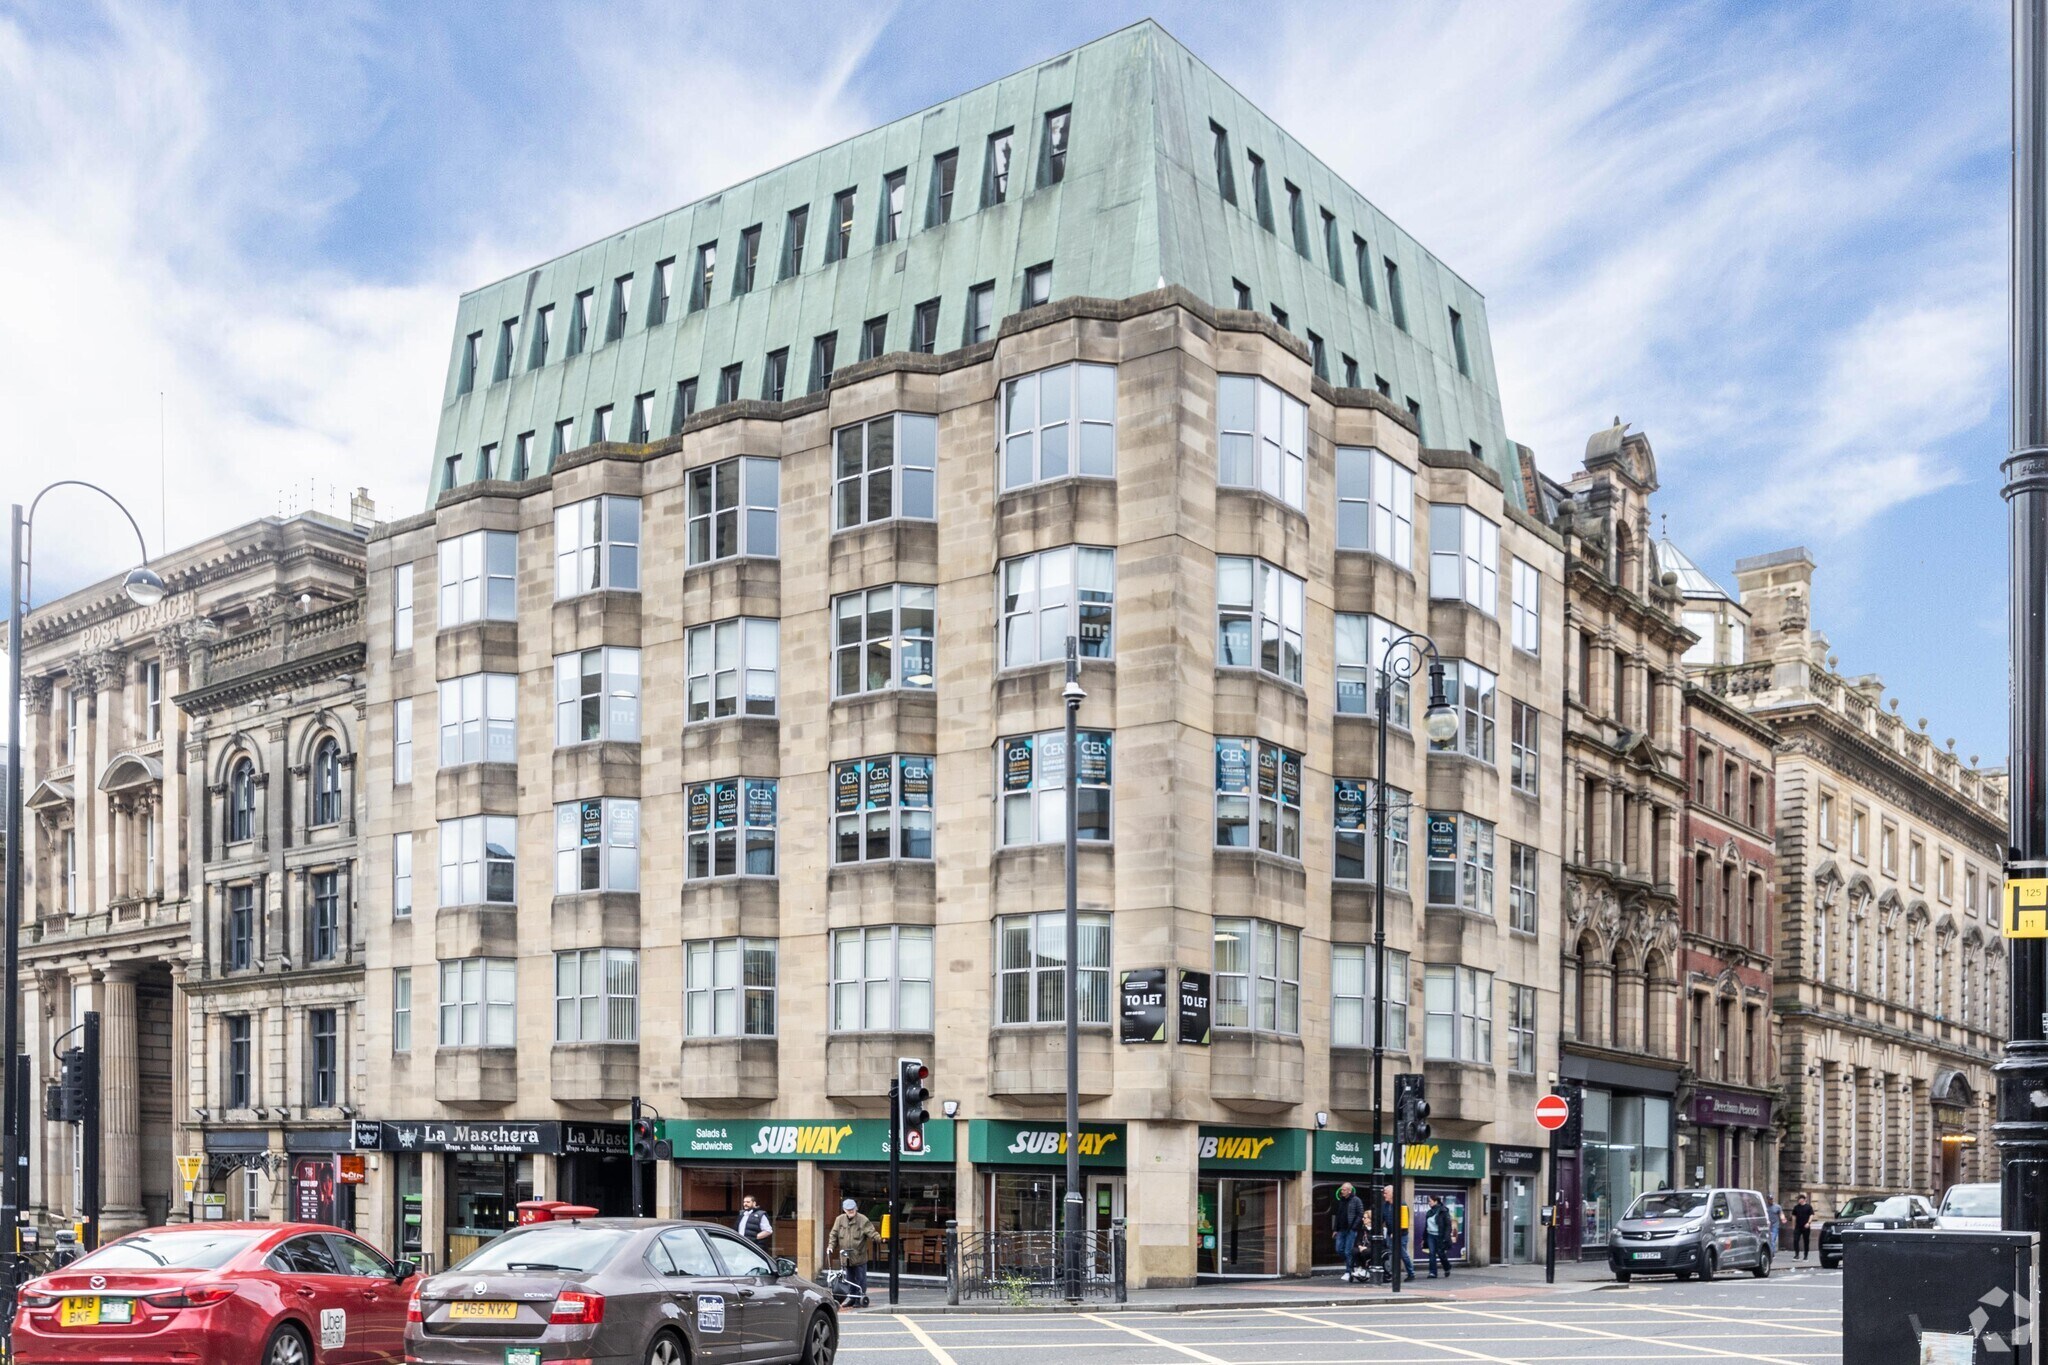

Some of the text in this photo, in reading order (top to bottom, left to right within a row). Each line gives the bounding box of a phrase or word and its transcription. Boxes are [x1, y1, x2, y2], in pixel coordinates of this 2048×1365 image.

[80, 592, 193, 652] POST OFFICE
[1081, 742, 1107, 754] CER
[1009, 748, 1030, 761] CER
[1220, 749, 1245, 761] CER
[840, 773, 858, 784] CER
[870, 768, 889, 780] CER
[904, 767, 928, 779] CER
[692, 793, 708, 805] CER
[719, 790, 736, 801] CER
[750, 789, 772, 800] CER
[1339, 790, 1362, 802] CER
[585, 809, 600, 820] CER
[1432, 822, 1453, 833] CER
[2026, 889, 2041, 897] 125
[2026, 920, 2034, 928] 11
[1125, 994, 1162, 1006] TO LET
[1182, 995, 1208, 1008] TO LET
[424, 1125, 540, 1143] La Maschera
[567, 1127, 629, 1146] La Masc
[696, 1128, 728, 1138] Salads &
[751, 1125, 853, 1154] SUBWAY
[470, 1144, 487, 1152] Salads
[493, 1144, 521, 1152] Sandwiches
[691, 1141, 733, 1151] Sandwiches
[1335, 1141, 1360, 1152] Salads &
[1331, 1154, 1364, 1166] Sandwiches
[1451, 1149, 1467, 1159] Salads
[1448, 1161, 1475, 1171] Sandwiches
[69, 1297, 95, 1310] WJ18
[454, 1302, 511, 1315] FW66 NVK
[69, 1311, 92, 1323] BKF
[322, 1311, 344, 1331] Uber
[514, 1354, 530, 1364] 508
